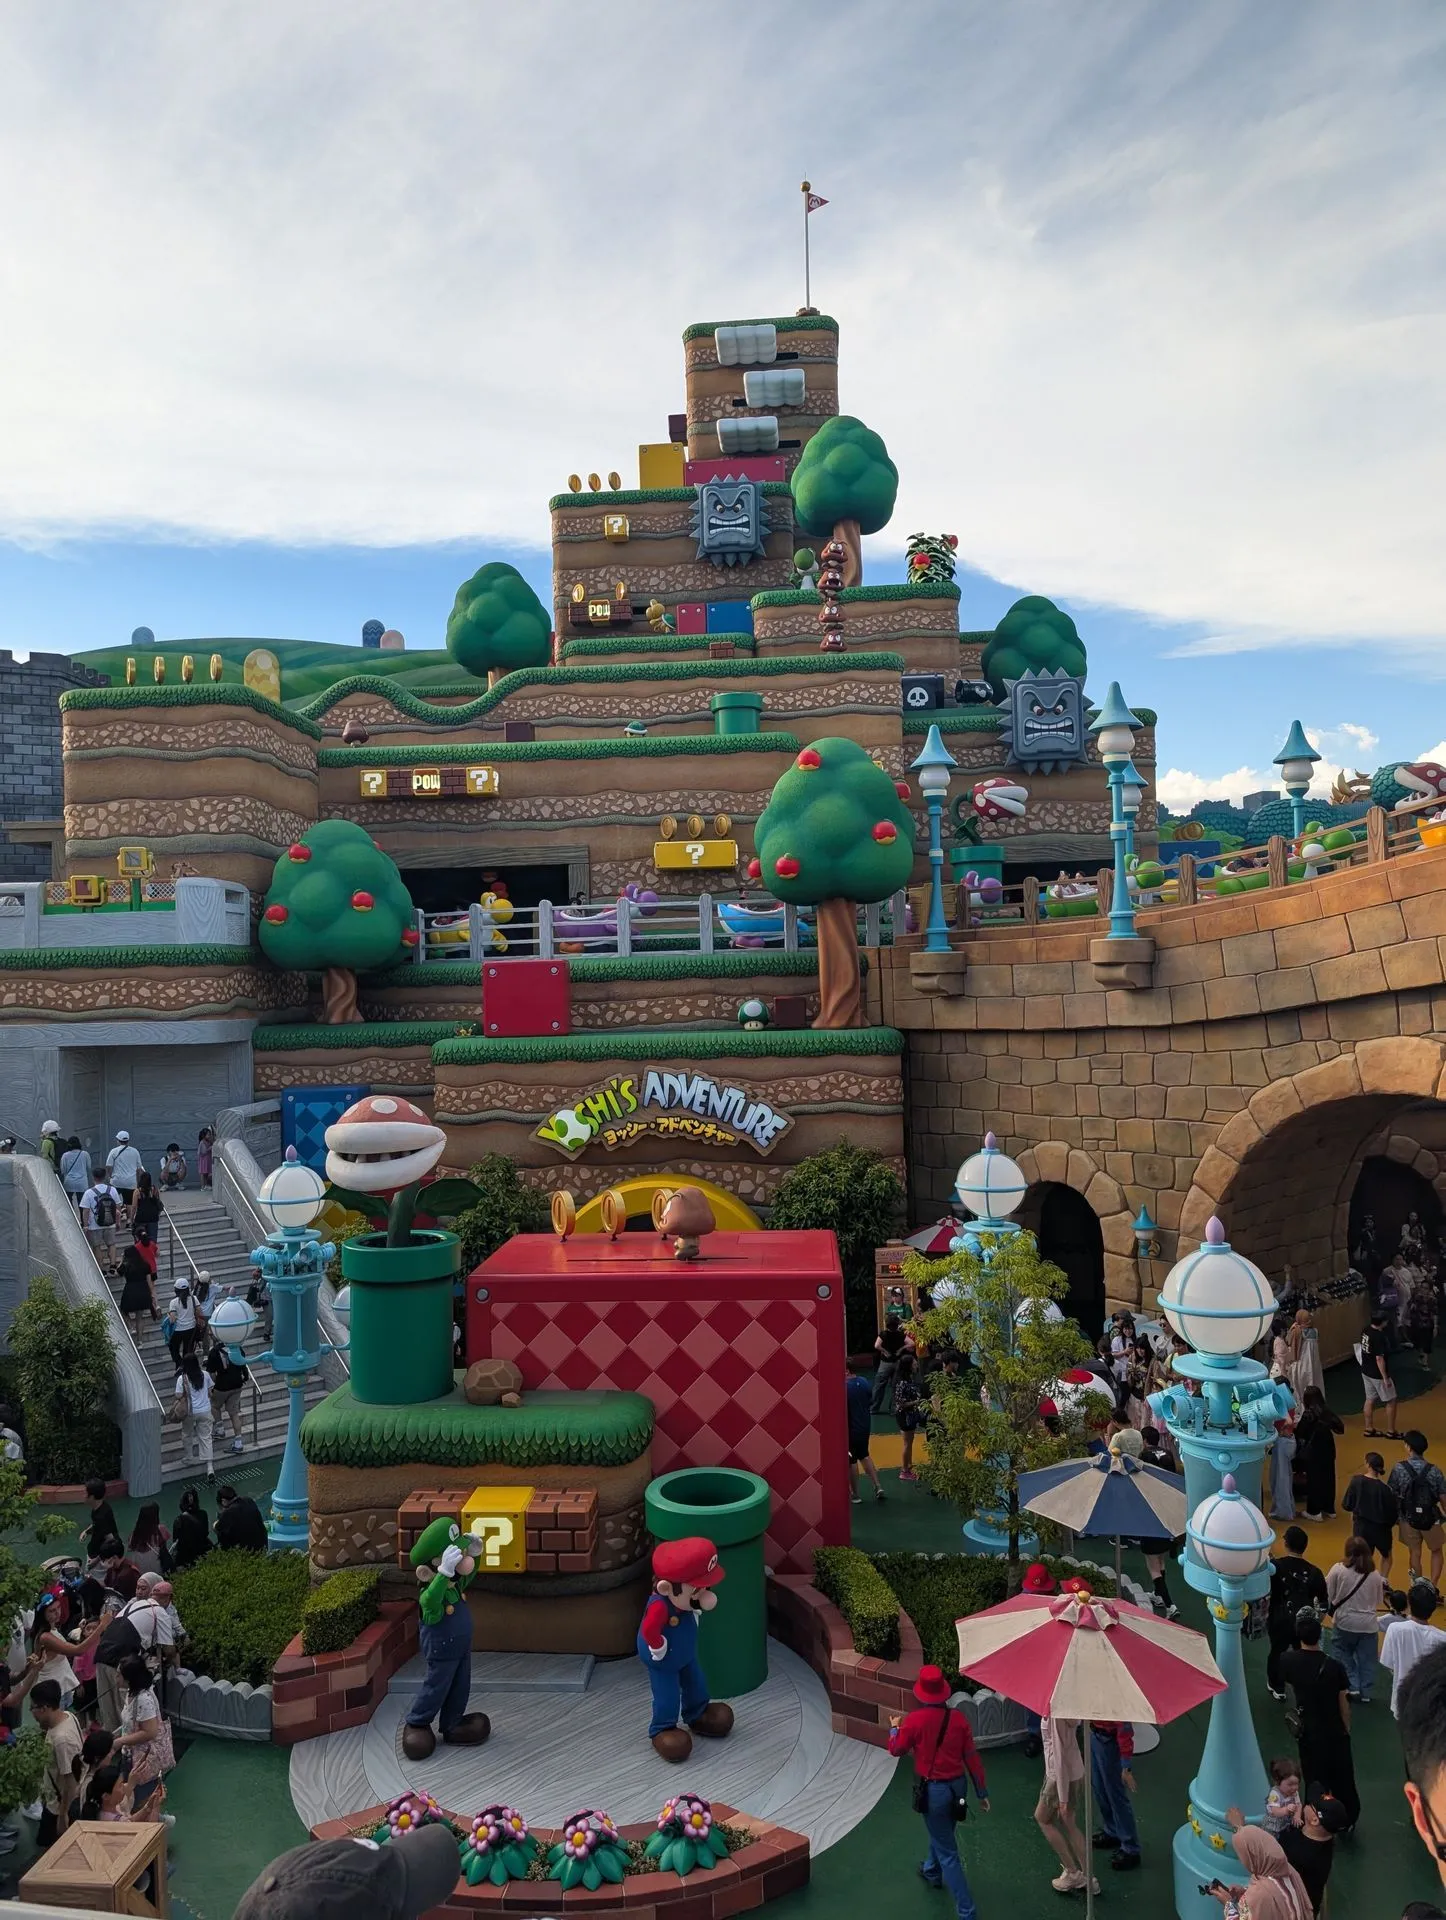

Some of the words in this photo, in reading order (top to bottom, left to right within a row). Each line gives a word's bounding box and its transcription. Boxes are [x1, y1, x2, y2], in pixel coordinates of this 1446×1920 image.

[608, 517, 623, 533] ?
[588, 604, 611, 617] POW
[363, 773, 383, 793] ?
[412, 774, 441, 790] POW
[469, 769, 489, 791] ?
[685, 843, 705, 865] ?
[643, 1071, 789, 1148] ADVENTURE
[603, 1116, 736, 1145] ヨッシー・アドベンチャー
[470, 1517, 514, 1567] ?
